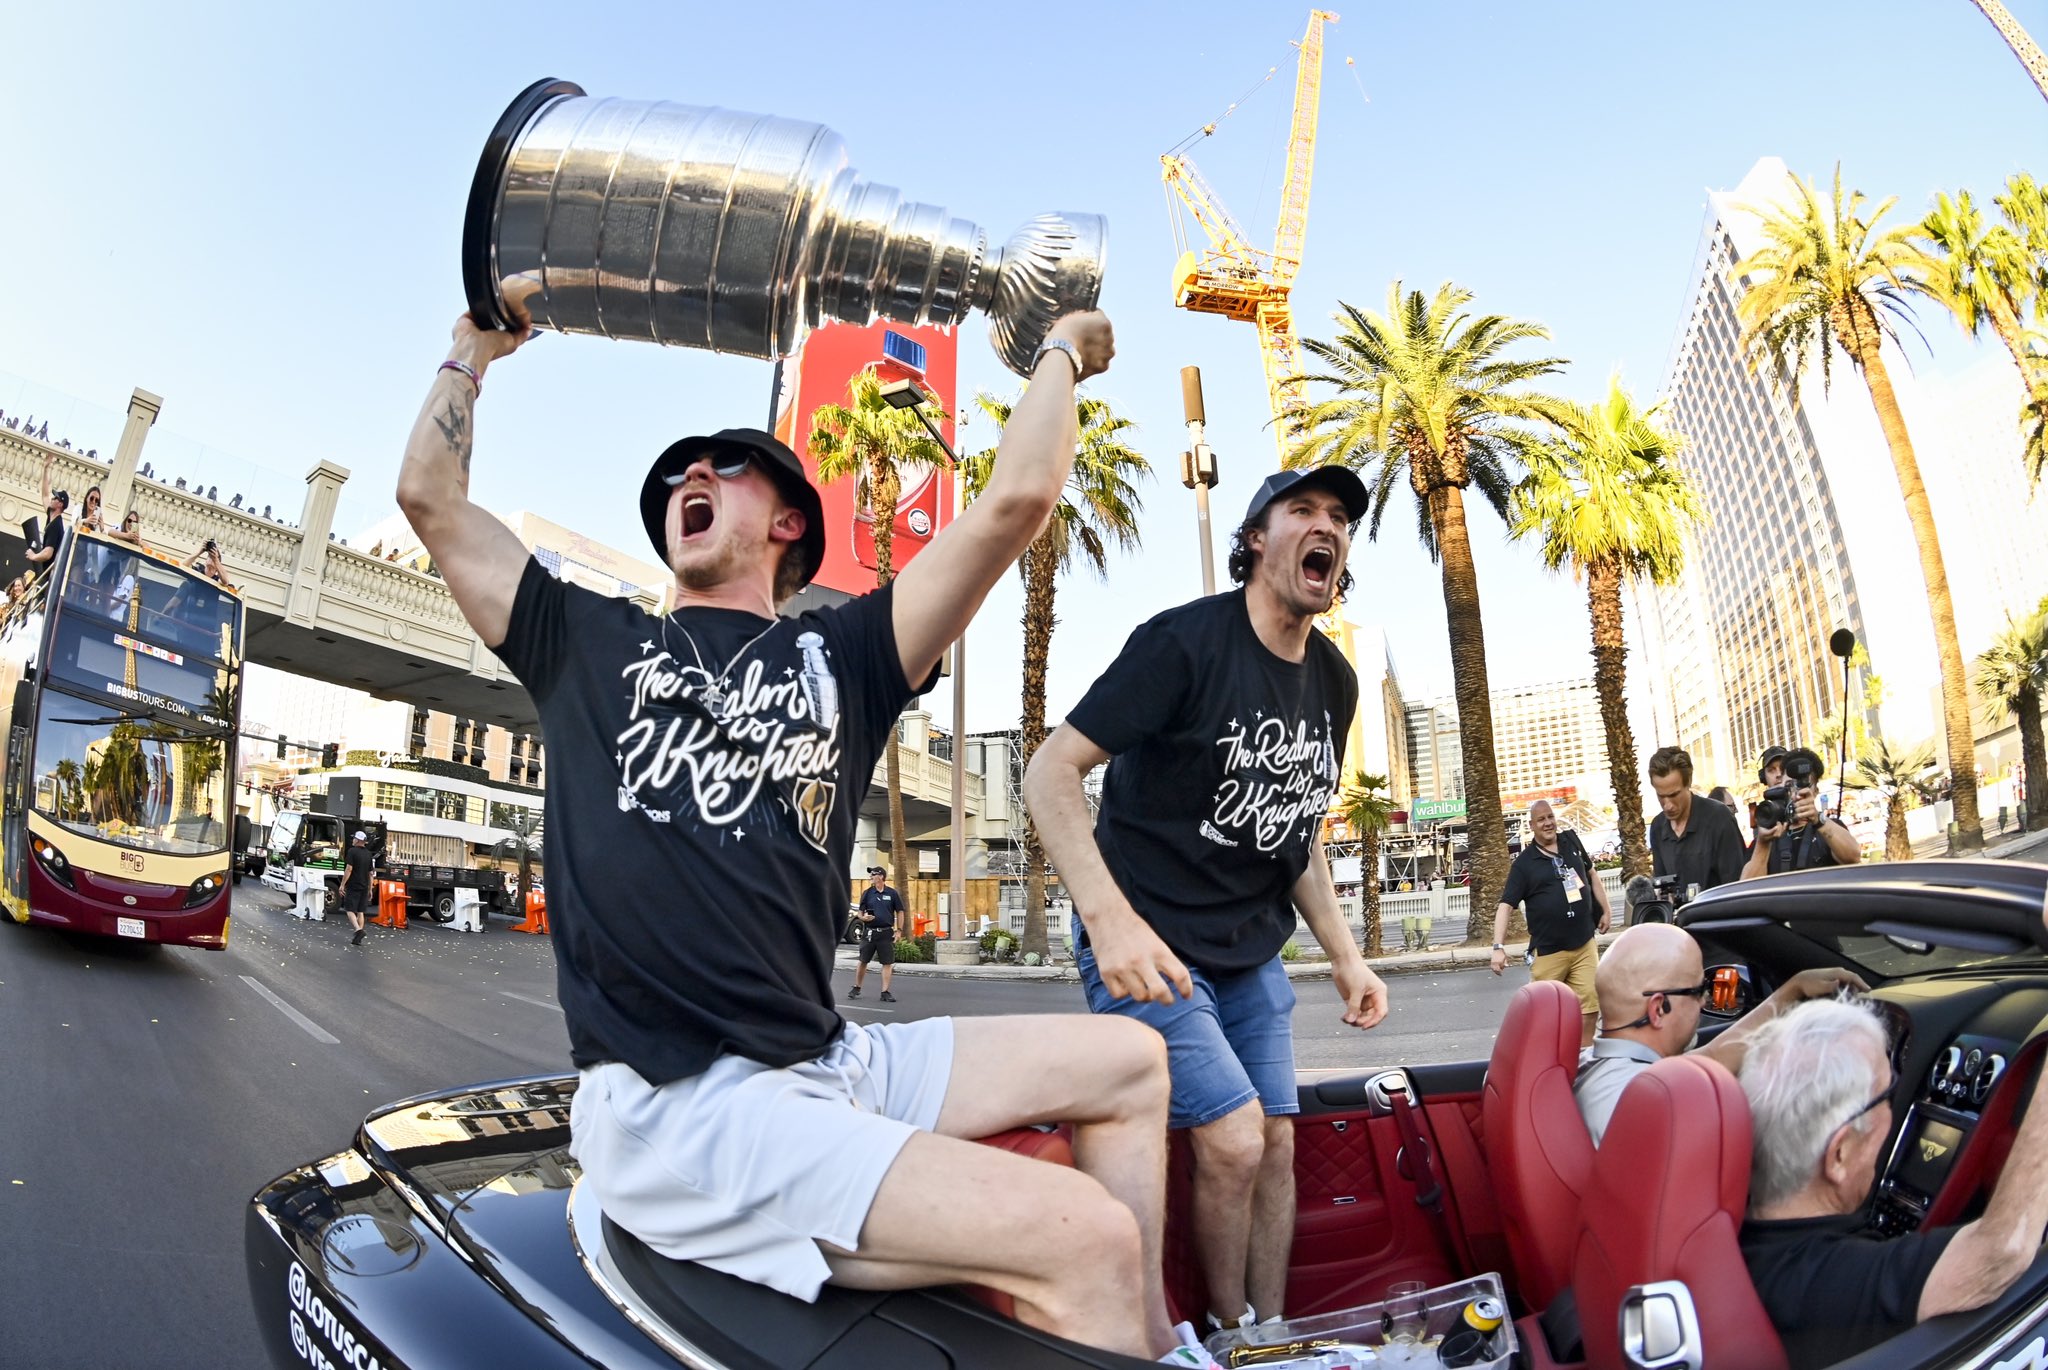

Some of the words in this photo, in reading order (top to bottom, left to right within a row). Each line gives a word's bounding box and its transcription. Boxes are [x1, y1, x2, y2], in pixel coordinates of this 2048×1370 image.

[1211, 282, 1239, 290] MORROW
[106, 682, 186, 716] BIGBUSTOURS.COM
[622, 652, 684, 720] The
[681, 660, 807, 725] alm
[728, 716, 780, 743] is
[1216, 726, 1255, 775] The
[1255, 718, 1324, 775] Realm
[1283, 764, 1312, 794] is
[120, 852, 134, 862] BIG
[120, 861, 134, 871] BUS
[289, 1261, 388, 1370] @LOTUSC
